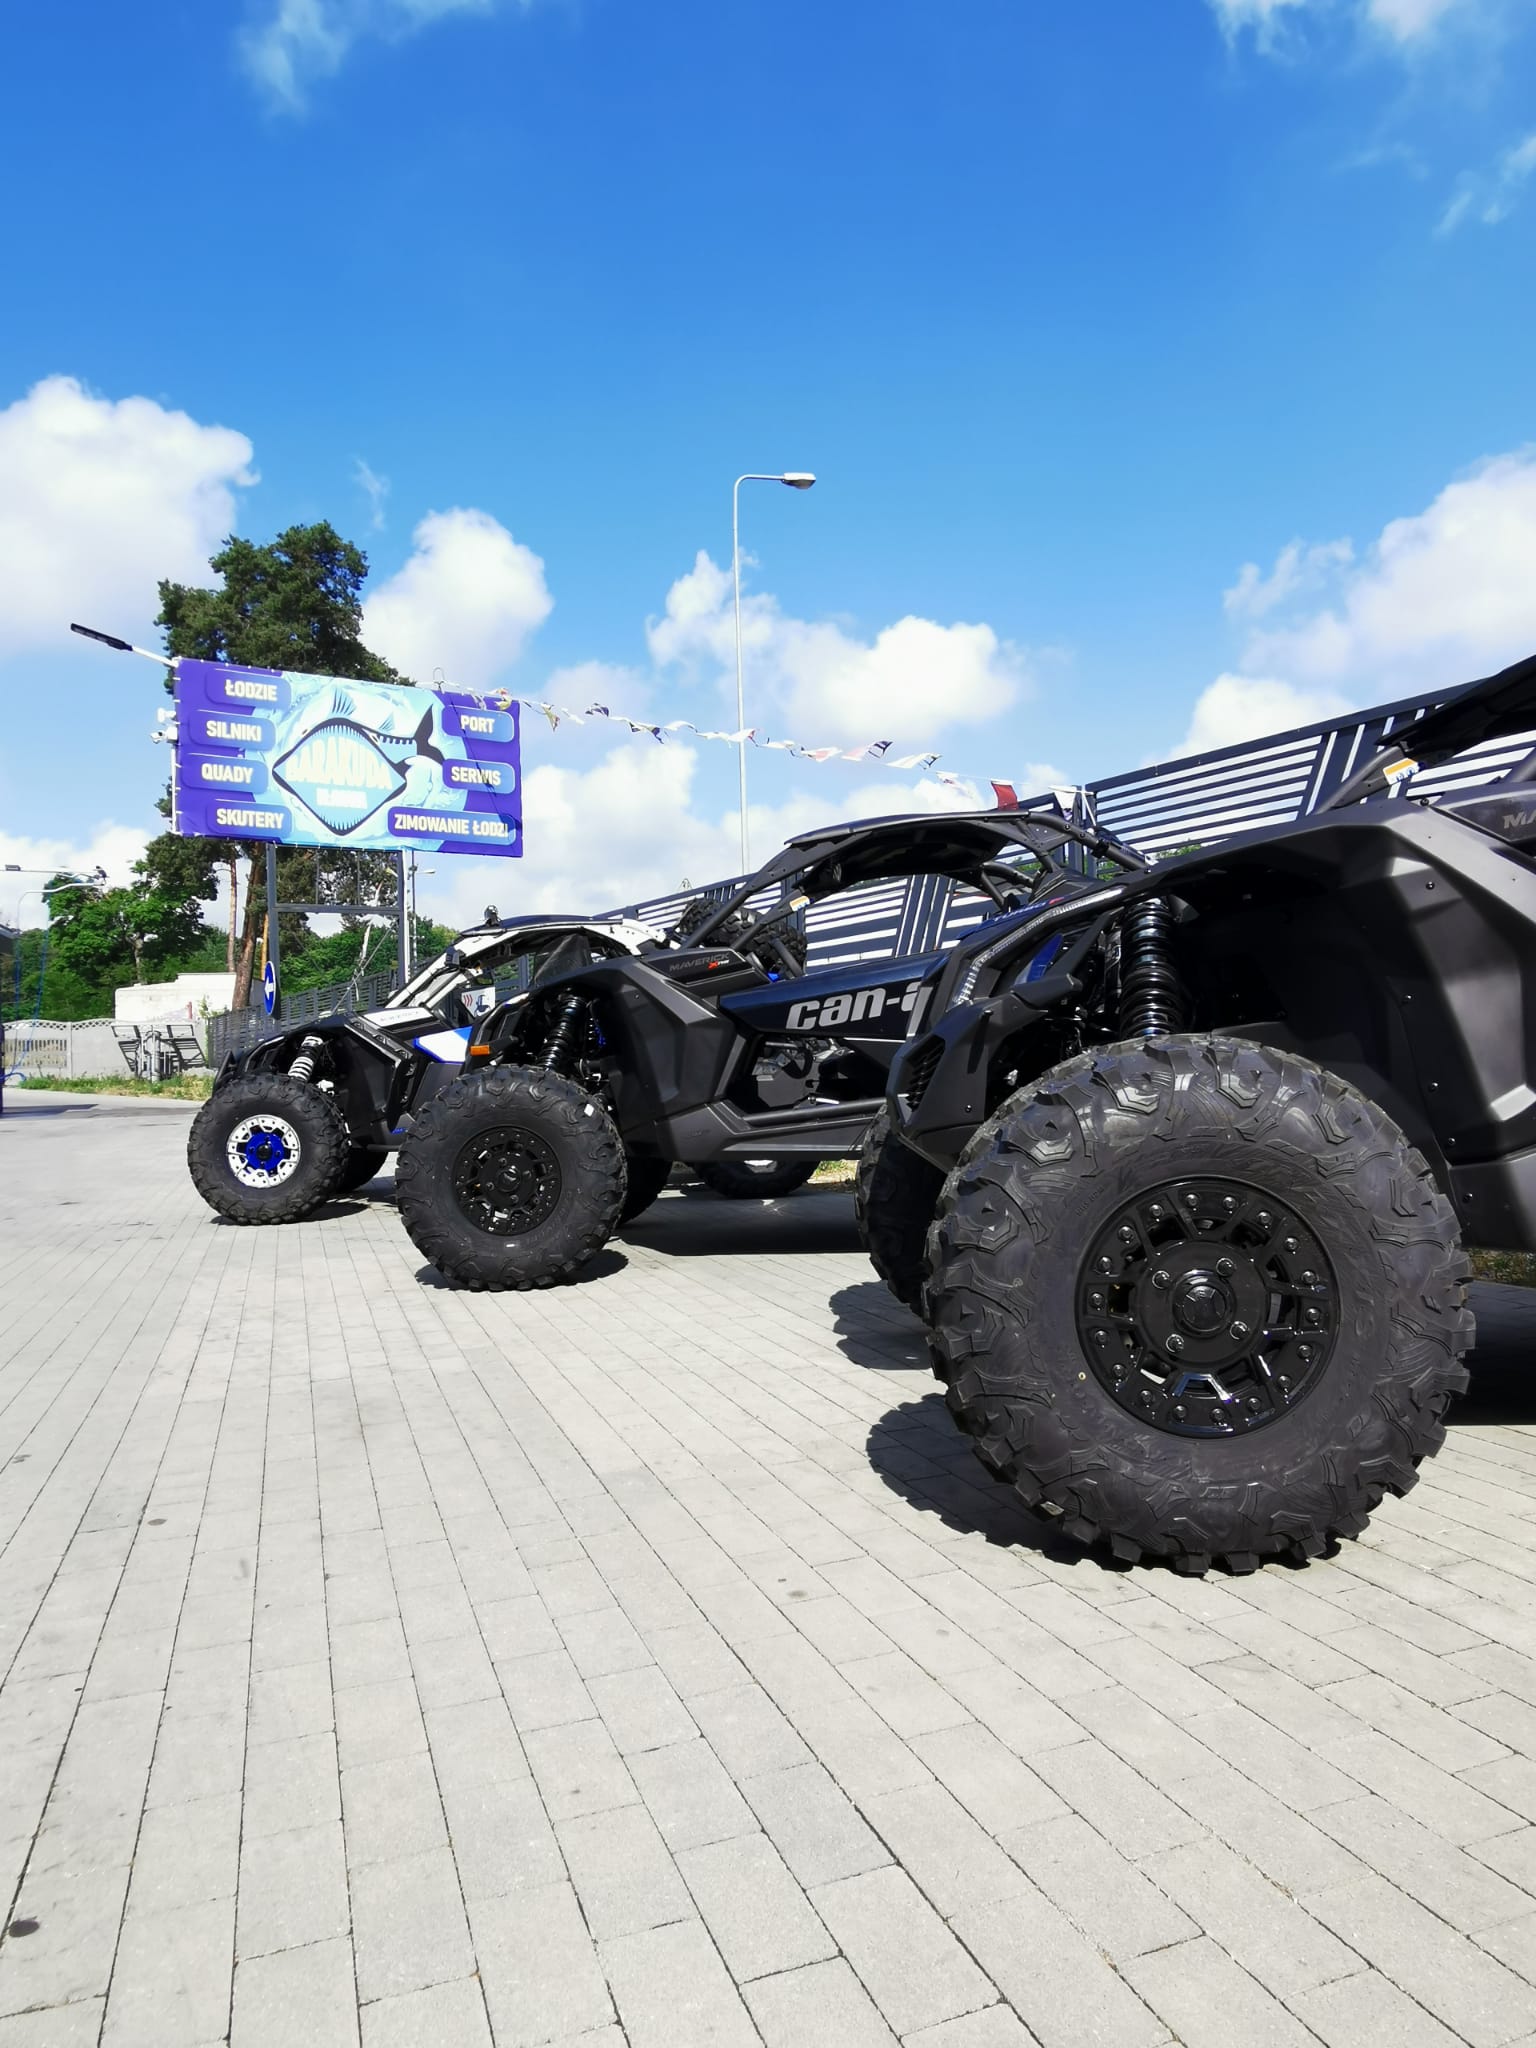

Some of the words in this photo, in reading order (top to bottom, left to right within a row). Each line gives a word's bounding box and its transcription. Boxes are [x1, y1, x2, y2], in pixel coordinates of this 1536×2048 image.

[225, 679, 278, 702] ŁODZIE
[206, 720, 262, 742] SILNIKI
[460, 715, 495, 733] PORT
[201, 763, 253, 784] QUADY
[451, 766, 501, 786] SERWIS
[216, 808, 284, 829] SKUTERY
[394, 813, 469, 834] ZIMOWANIE
[472, 820, 509, 838] ŁODZI
[669, 952, 730, 972] MAVERICK
